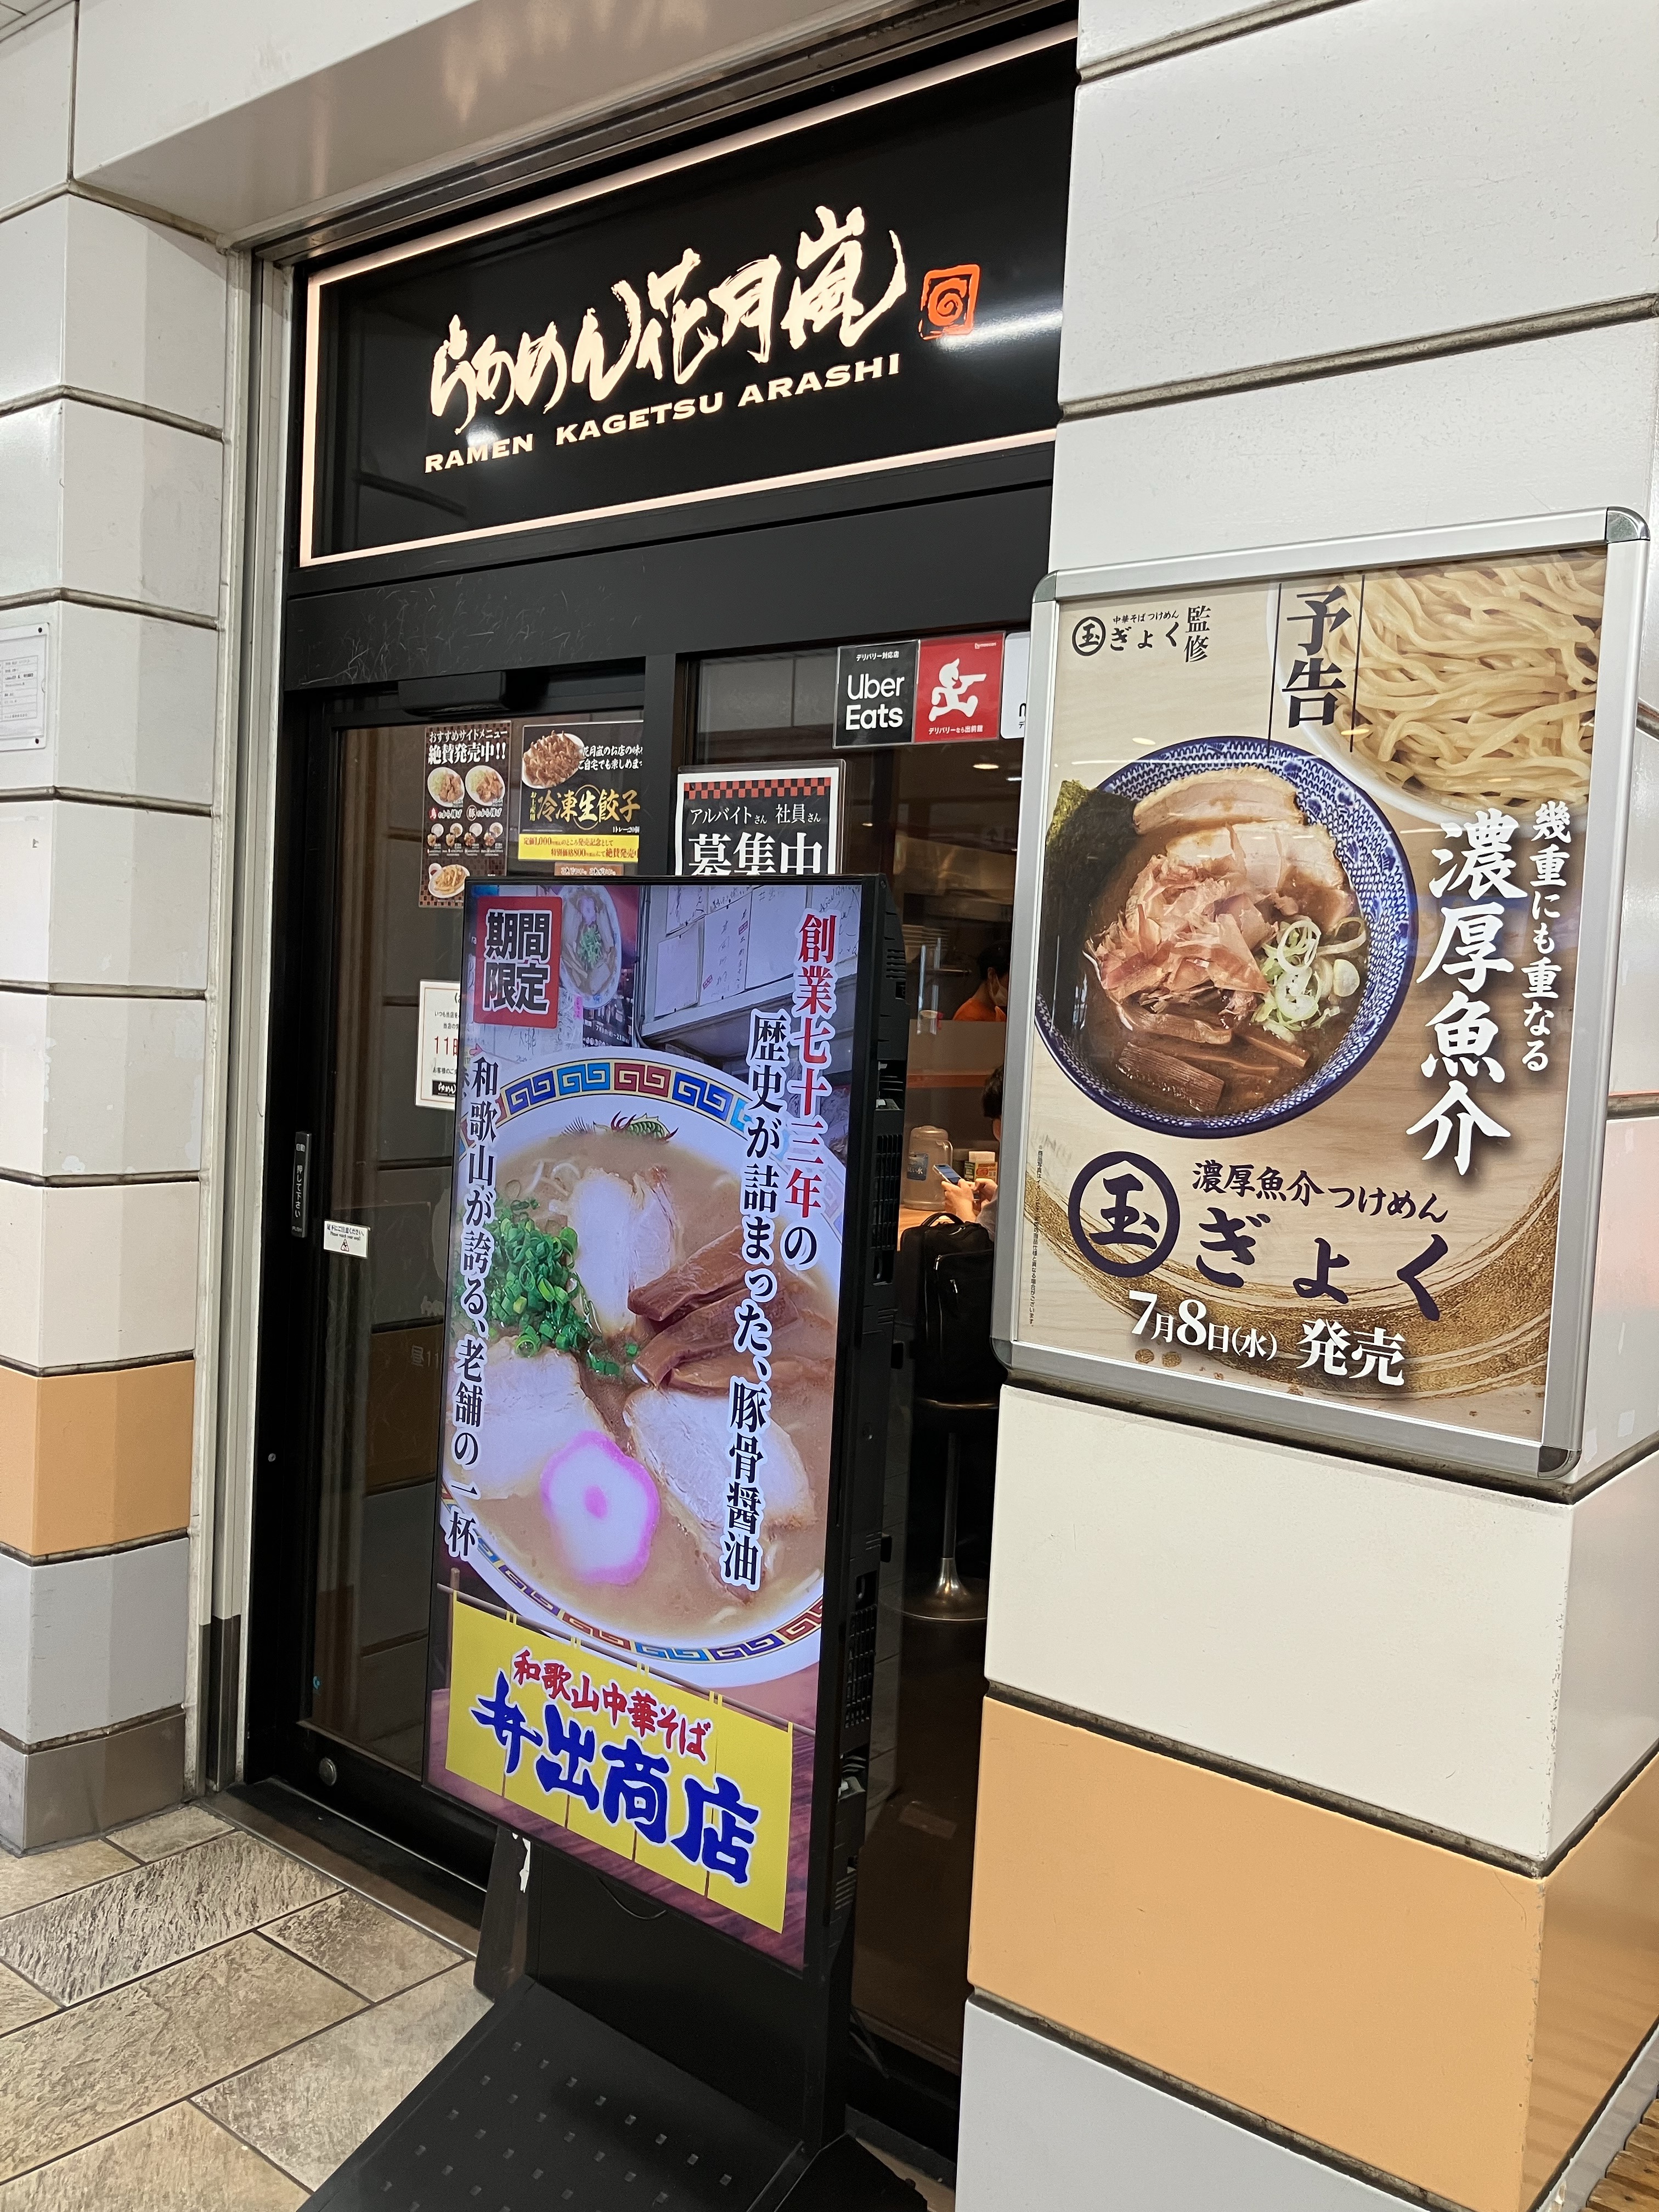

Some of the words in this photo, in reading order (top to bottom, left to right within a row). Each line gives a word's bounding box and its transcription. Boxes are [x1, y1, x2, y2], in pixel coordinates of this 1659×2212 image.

[424, 433, 534, 474] RAMEN
[555, 392, 724, 446] KAGETSU
[738, 353, 900, 407] ARASHI
[1110, 622, 1180, 651] ぎょく
[1113, 612, 1146, 624] 中華そば
[1148, 610, 1180, 621] つけめん
[1183, 605, 1211, 663] 監修
[856, 651, 900, 662] デリバリー対応店
[1282, 585, 1351, 729] 予告
[847, 673, 905, 701] Uber
[429, 729, 508, 743] おすすめサイドメニュー
[845, 703, 904, 731] Eats
[928, 725, 984, 735] デリバリーなら出前館
[537, 789, 641, 823] 冷凍生餃子
[690, 805, 768, 825] アルバイトさん
[775, 803, 822, 824] 社員さん
[688, 832, 823, 876] 募集中
[486, 910, 550, 961] 期間
[1520, 801, 1571, 1072] 幾重にも重なる
[483, 962, 549, 1014] 限定
[1407, 809, 1527, 1176] 濃厚魚介
[434, 1011, 460, 1019] いつも当店を
[784, 913, 837, 1266] 創業七十三年の
[1068, 1150, 1180, 1278] 玉
[1196, 1206, 1449, 1322] ぎょく
[448, 1057, 499, 1556] 和歌山が誇る、老舗の一杯
[723, 1014, 788, 1585] 歴史が詰まった、豚骨醤油
[1128, 1290, 1278, 1362] 7月8日(水)
[1296, 1318, 1406, 1387] 発売
[512, 1649, 712, 1762] 和歌山中華そば
